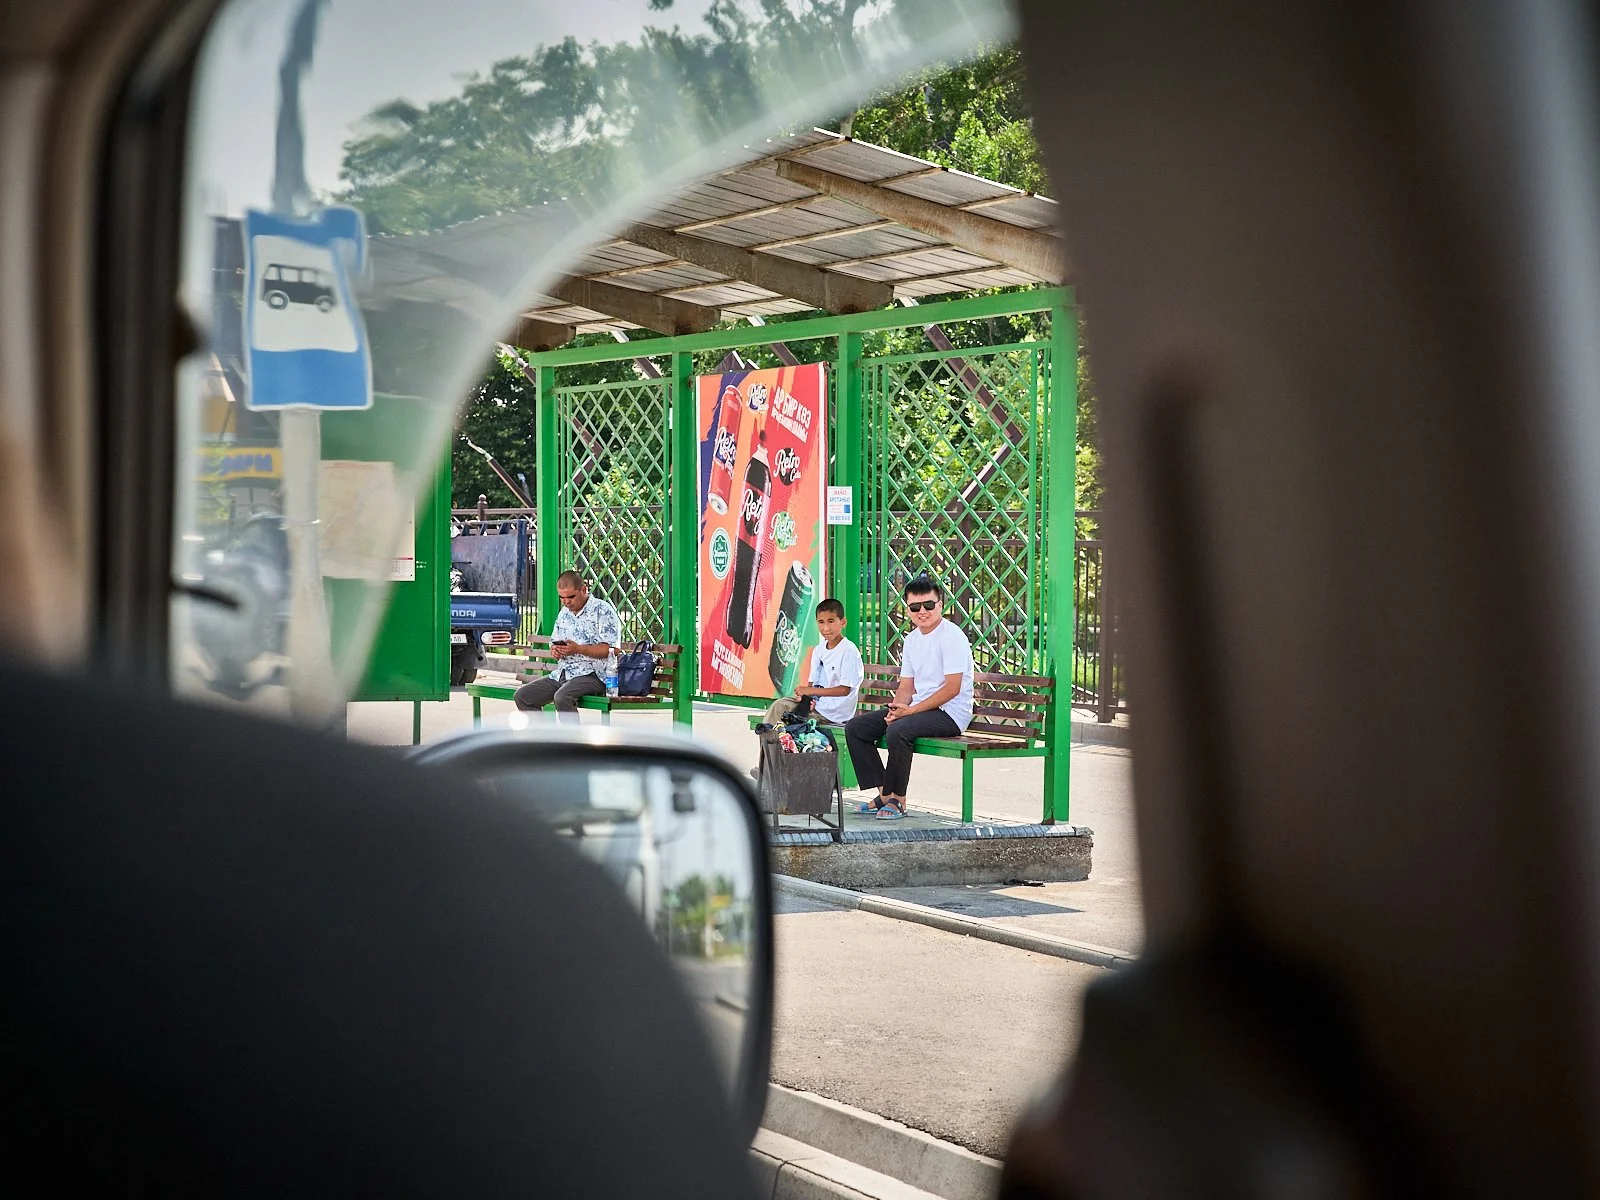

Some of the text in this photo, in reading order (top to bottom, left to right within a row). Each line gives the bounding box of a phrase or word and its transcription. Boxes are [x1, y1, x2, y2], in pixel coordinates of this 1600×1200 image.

[774, 386, 785, 410] АР
[782, 393, 798, 417] БИР
[773, 448, 800, 477] Retro
[770, 512, 796, 541] Retro
[451, 609, 477, 617] NDAI
